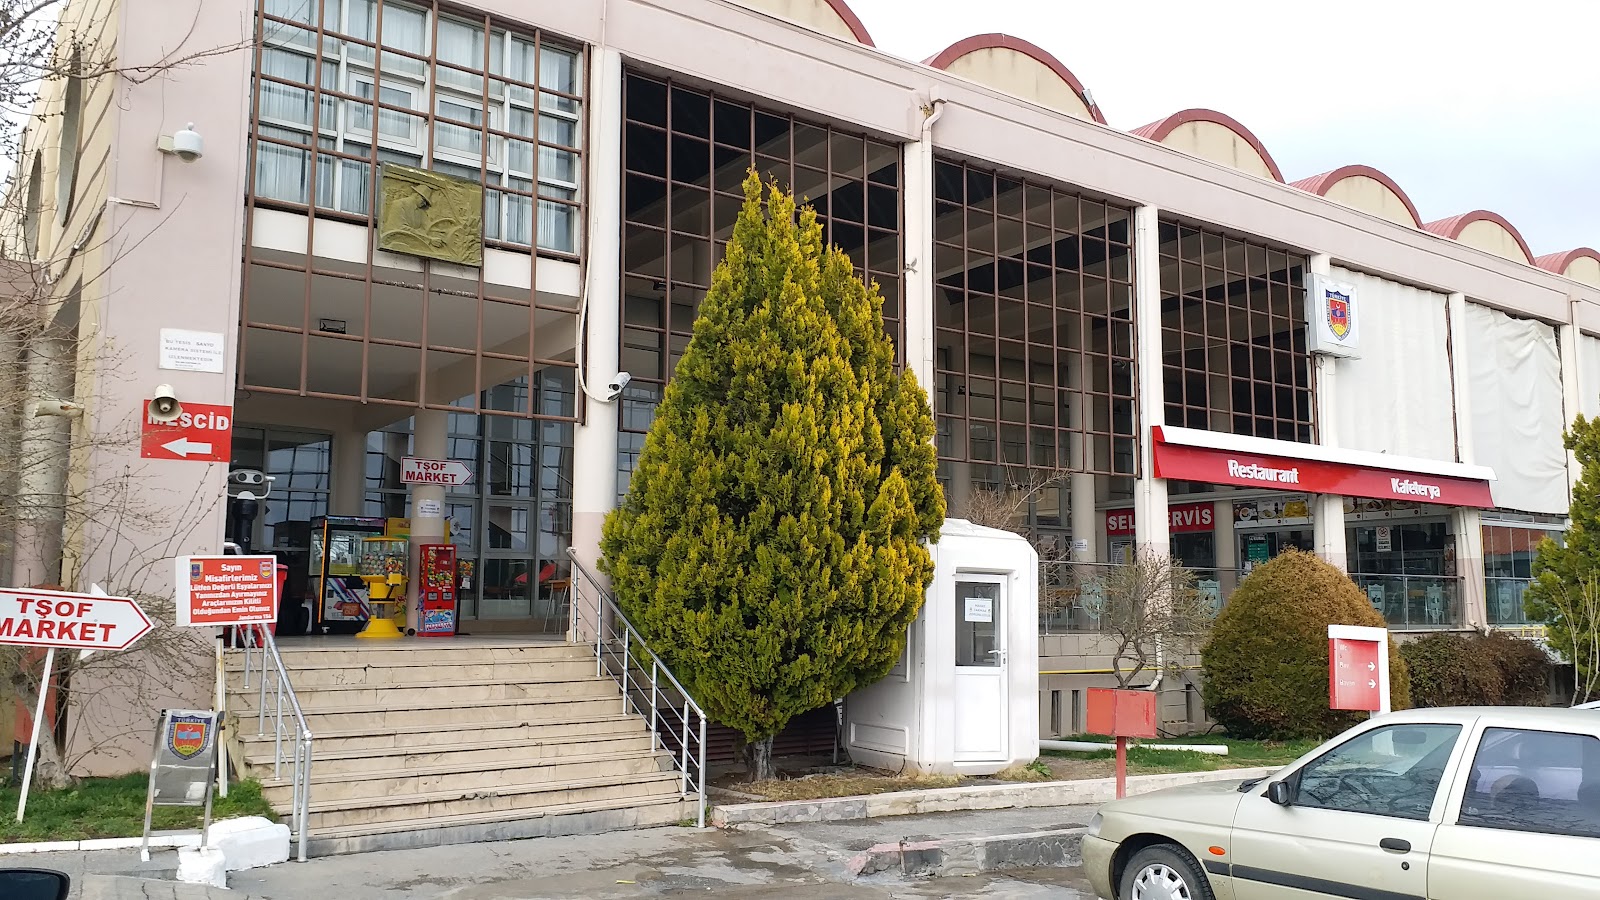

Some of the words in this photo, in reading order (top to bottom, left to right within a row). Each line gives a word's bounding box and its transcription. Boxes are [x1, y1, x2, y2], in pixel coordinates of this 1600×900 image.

[415, 461, 447, 471] TŞOF
[1227, 459, 1299, 484] Restaurant
[405, 470, 457, 483] MARKET
[1390, 477, 1441, 500] Kafeterya
[221, 564, 242, 572] Sayın
[205, 574, 258, 582] Misafirlerimiz
[16, 598, 93, 619] TŞOF
[0, 617, 116, 642] MARKET
